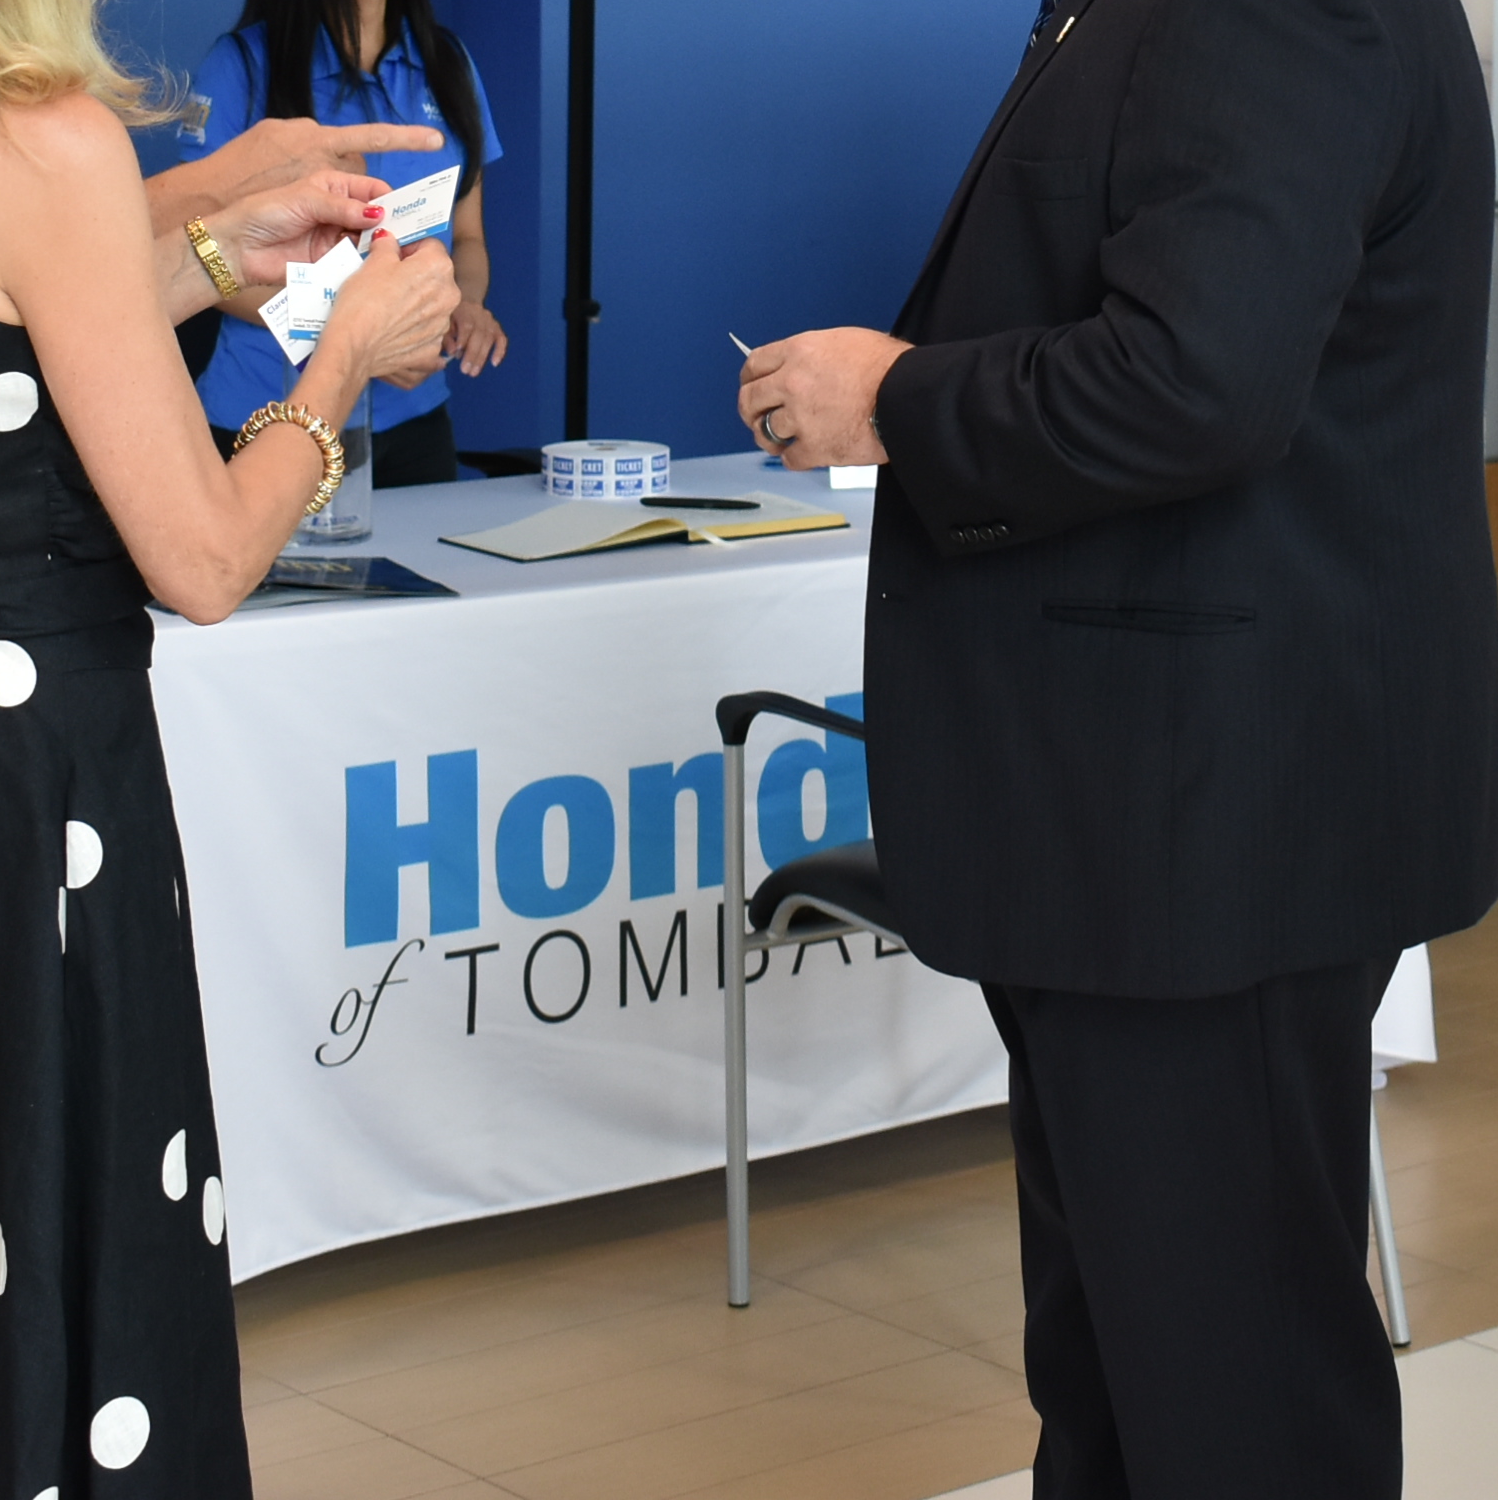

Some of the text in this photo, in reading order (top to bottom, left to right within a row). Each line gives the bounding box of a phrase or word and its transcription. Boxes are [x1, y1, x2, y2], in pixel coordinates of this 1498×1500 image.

[391, 196, 427, 217] Honda
[616, 461, 642, 472] TICKET
[344, 691, 869, 948] Hond
[314, 937, 425, 1067] of
